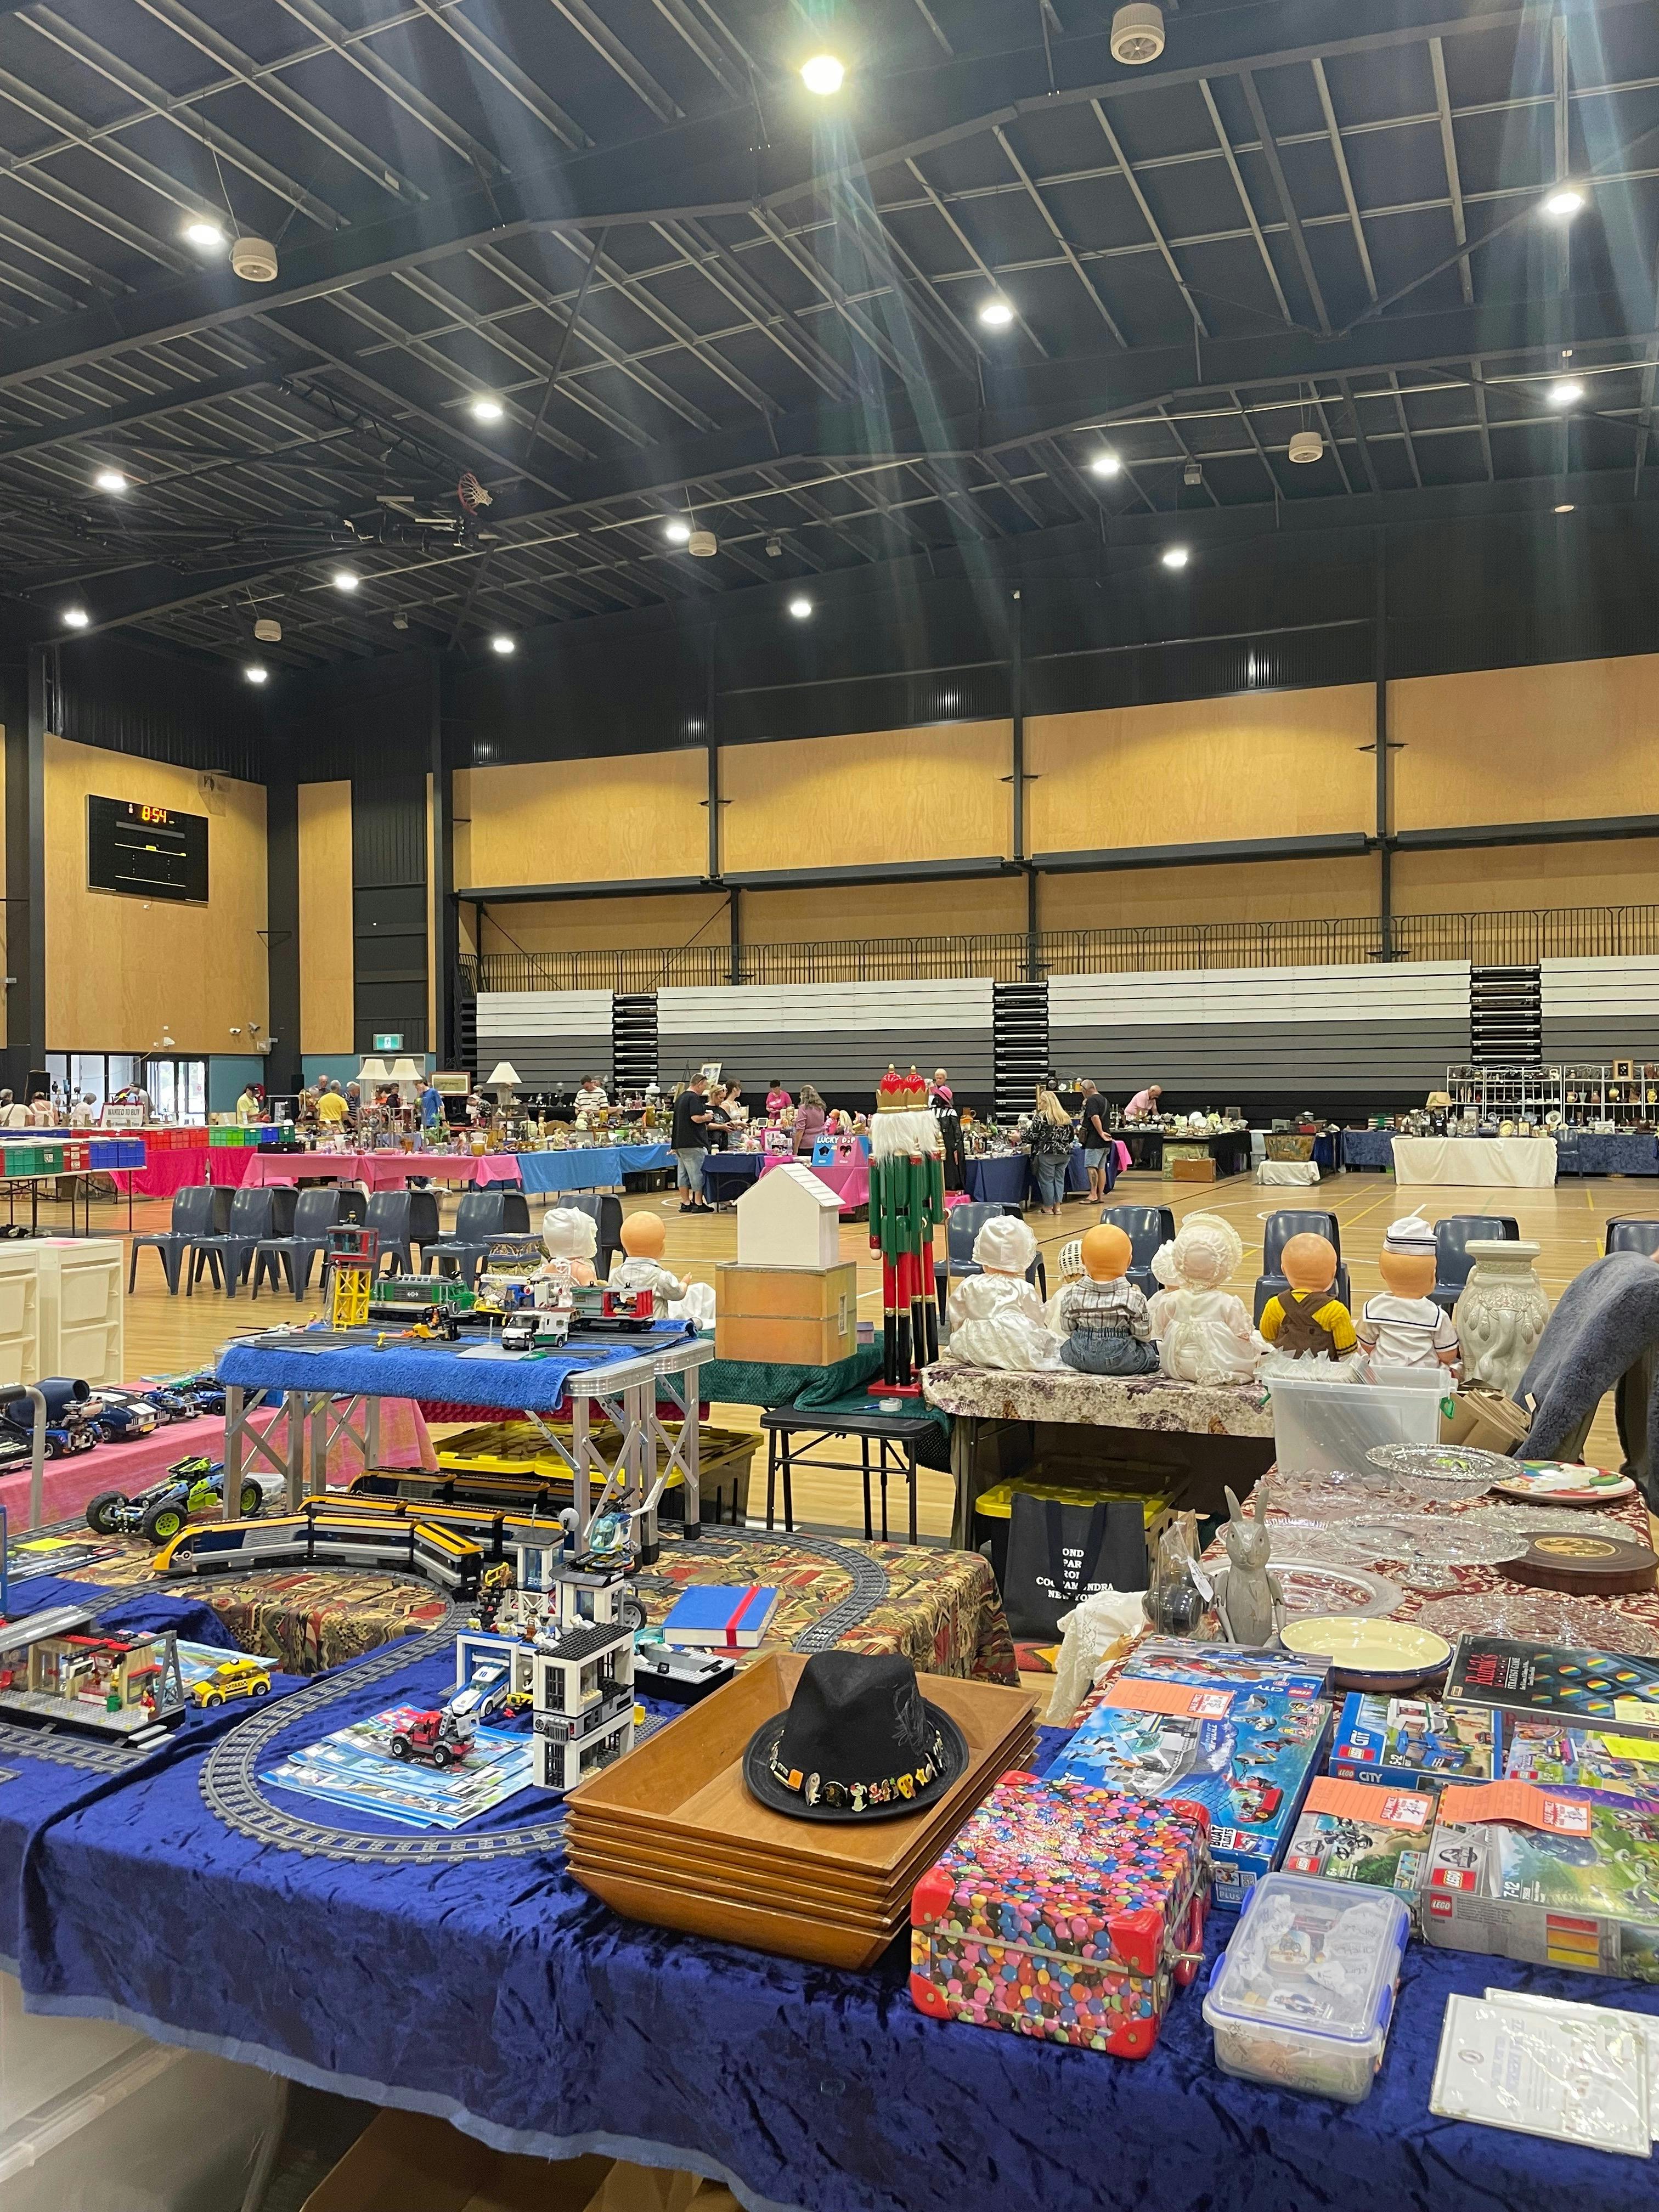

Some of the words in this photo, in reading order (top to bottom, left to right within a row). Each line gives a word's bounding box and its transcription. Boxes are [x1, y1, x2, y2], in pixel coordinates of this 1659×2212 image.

[1062, 1548, 1085, 1558] OND
[1510, 1657, 1520, 1669] GAME
[1465, 1654, 1498, 1686] Rubik's
[1507, 1668, 1519, 1690] STRATEGY
[1254, 1684, 1284, 1692] CITY
[1350, 1729, 1371, 1746] CITY
[1389, 1754, 1403, 1767] 5-12
[1338, 1769, 1355, 1778] LEGO
[1358, 1771, 1383, 1784] CITY
[1385, 1797, 1396, 1809] PRICE
[1544, 1801, 1554, 1813] PRICE
[1381, 1808, 1392, 1819] SALE
[1544, 1812, 1554, 1825] SALE
[1222, 1828, 1234, 1848] FLOATS
[1326, 1867, 1338, 1877] 6+
[1444, 1870, 1463, 1888] LEGO
[1219, 1891, 1240, 1900] PLUS
[1504, 1881, 1520, 1898] 7-12
[1432, 1900, 1452, 1910] LEGO
